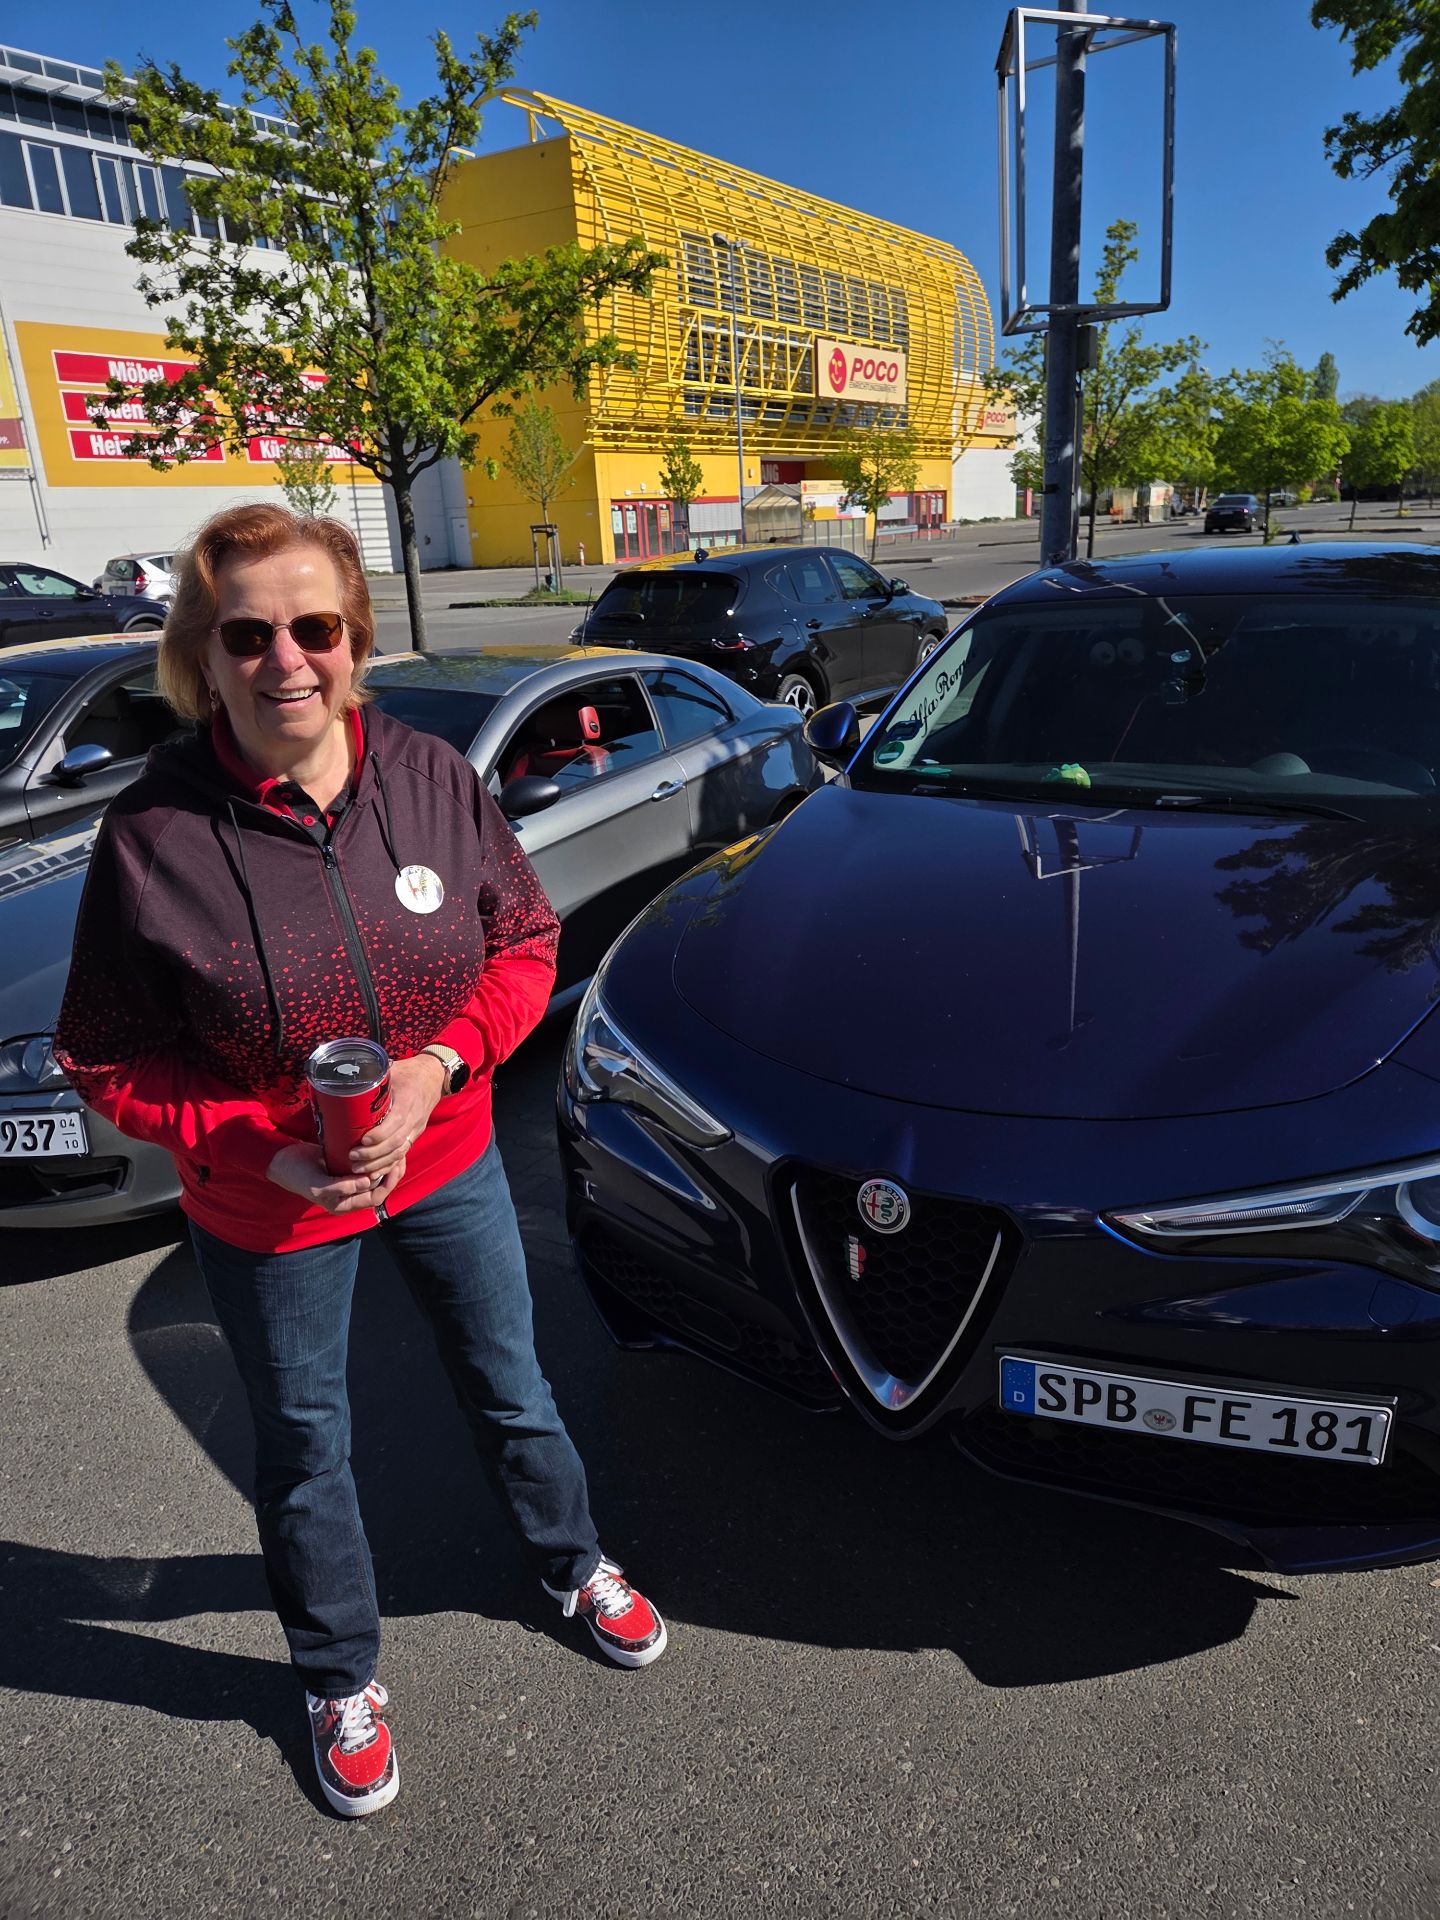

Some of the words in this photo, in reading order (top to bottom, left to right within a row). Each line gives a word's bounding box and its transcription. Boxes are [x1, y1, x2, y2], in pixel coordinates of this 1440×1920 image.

[108, 360, 165, 384] Möbel
[850, 357, 899, 383] POCO
[985, 411, 1006, 424] POCO
[60, 1119, 76, 1129] 04
[64, 1139, 79, 1150] 10
[861, 1186, 877, 1203] ALFA
[880, 1185, 904, 1213] ROMEO
[1013, 1390, 1025, 1403] D
[1037, 1373, 1138, 1423] SPB
[1182, 1396, 1252, 1441] FE
[1268, 1407, 1373, 1457] 181
